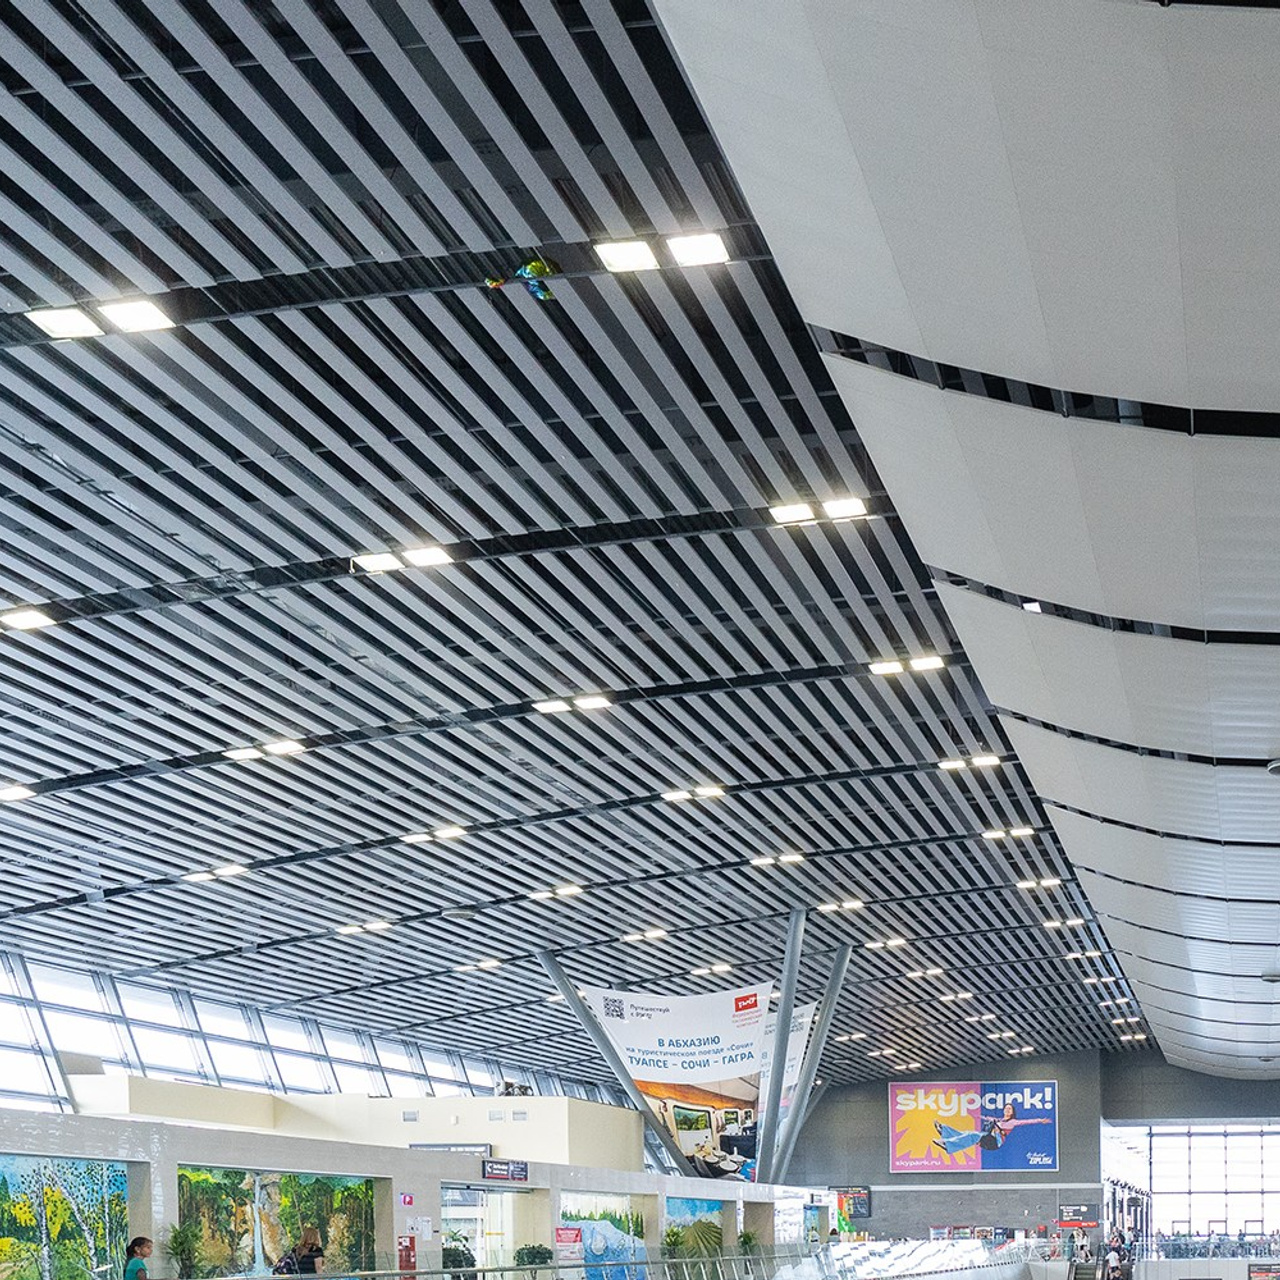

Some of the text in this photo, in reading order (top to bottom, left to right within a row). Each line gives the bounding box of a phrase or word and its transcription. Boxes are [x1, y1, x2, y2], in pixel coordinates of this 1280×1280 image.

[657, 1035, 721, 1048] В АБХАЗИЮ
[628, 1055, 669, 1069] ТУАПСЕ
[681, 1058, 711, 1069] СОЧИ
[722, 1051, 754, 1065] ГАГРА
[895, 1086, 1054, 1117] skypark!
[895, 1159, 941, 1167] skypark.ru
